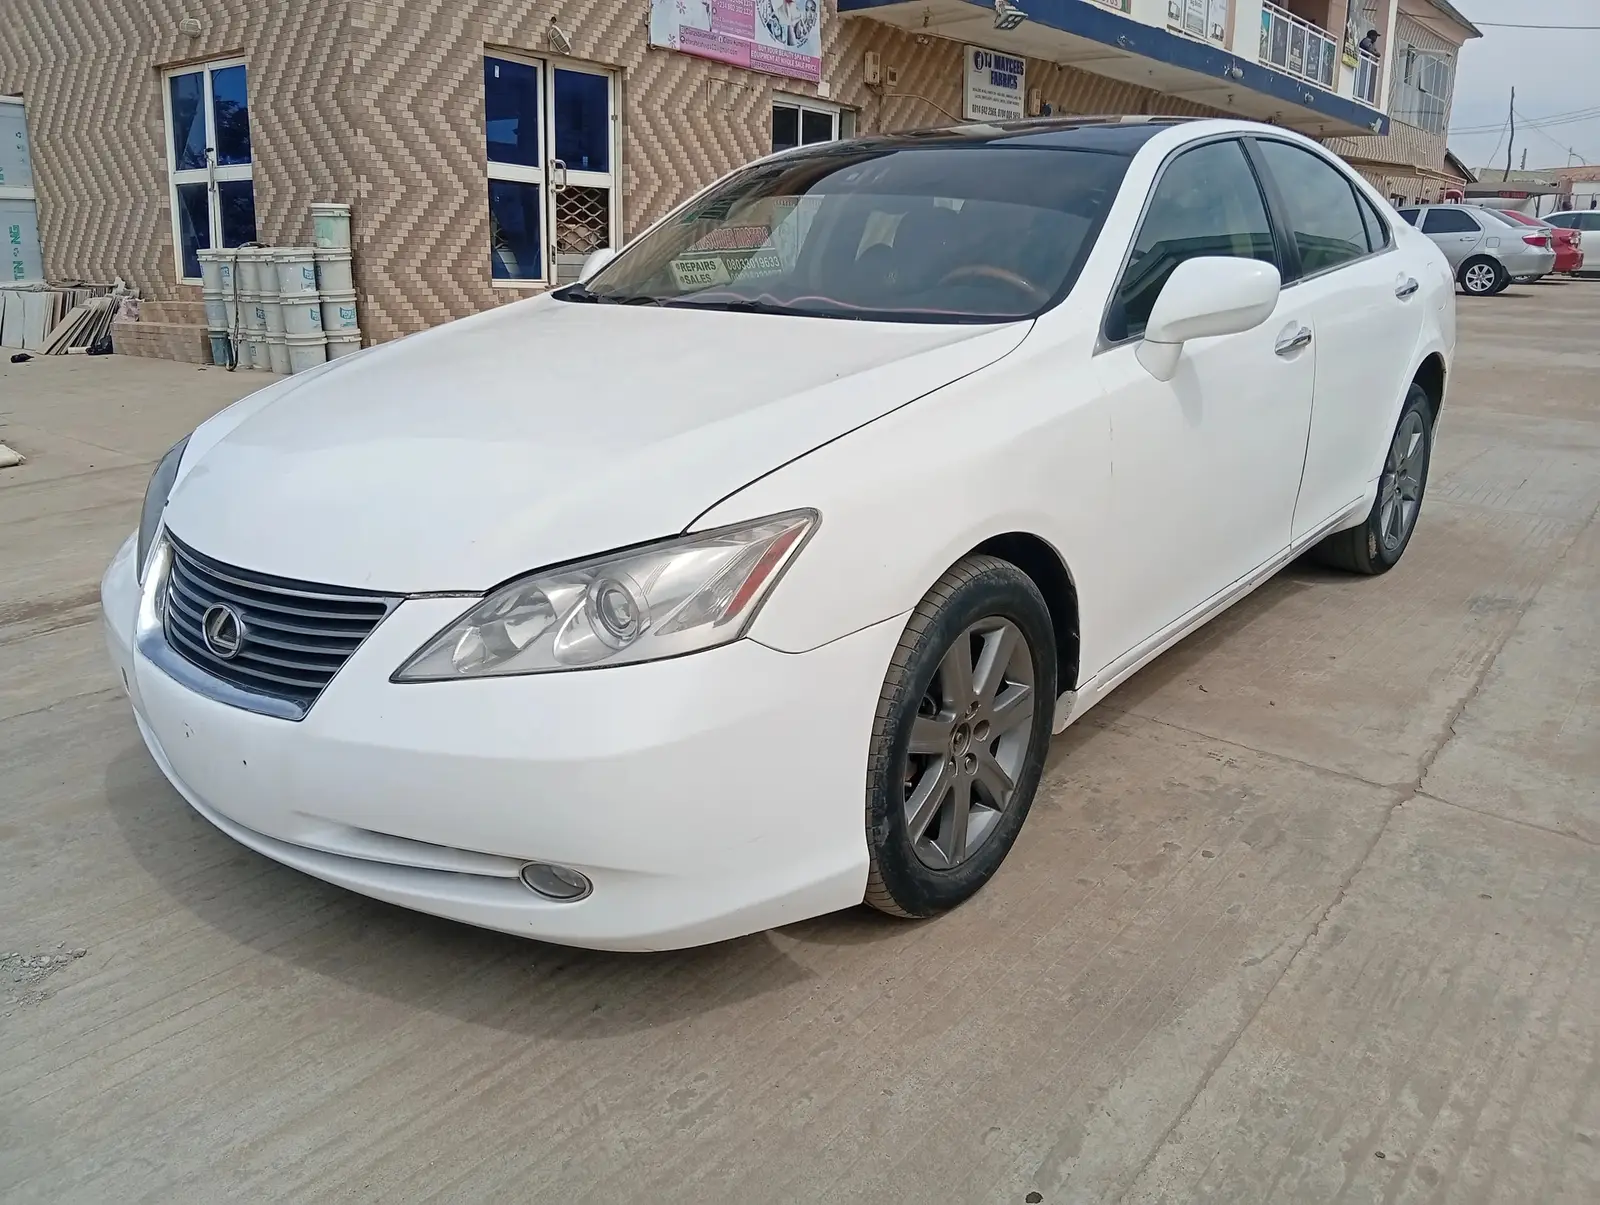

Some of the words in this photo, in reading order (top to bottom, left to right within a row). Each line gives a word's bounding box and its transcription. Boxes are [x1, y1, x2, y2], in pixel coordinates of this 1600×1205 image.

[779, 49, 793, 59] BEAUTY
[984, 52, 991, 68] TJ
[991, 70, 1018, 89] FABRICS
[680, 260, 717, 273] REPAIRS
[685, 274, 712, 285] SALES
